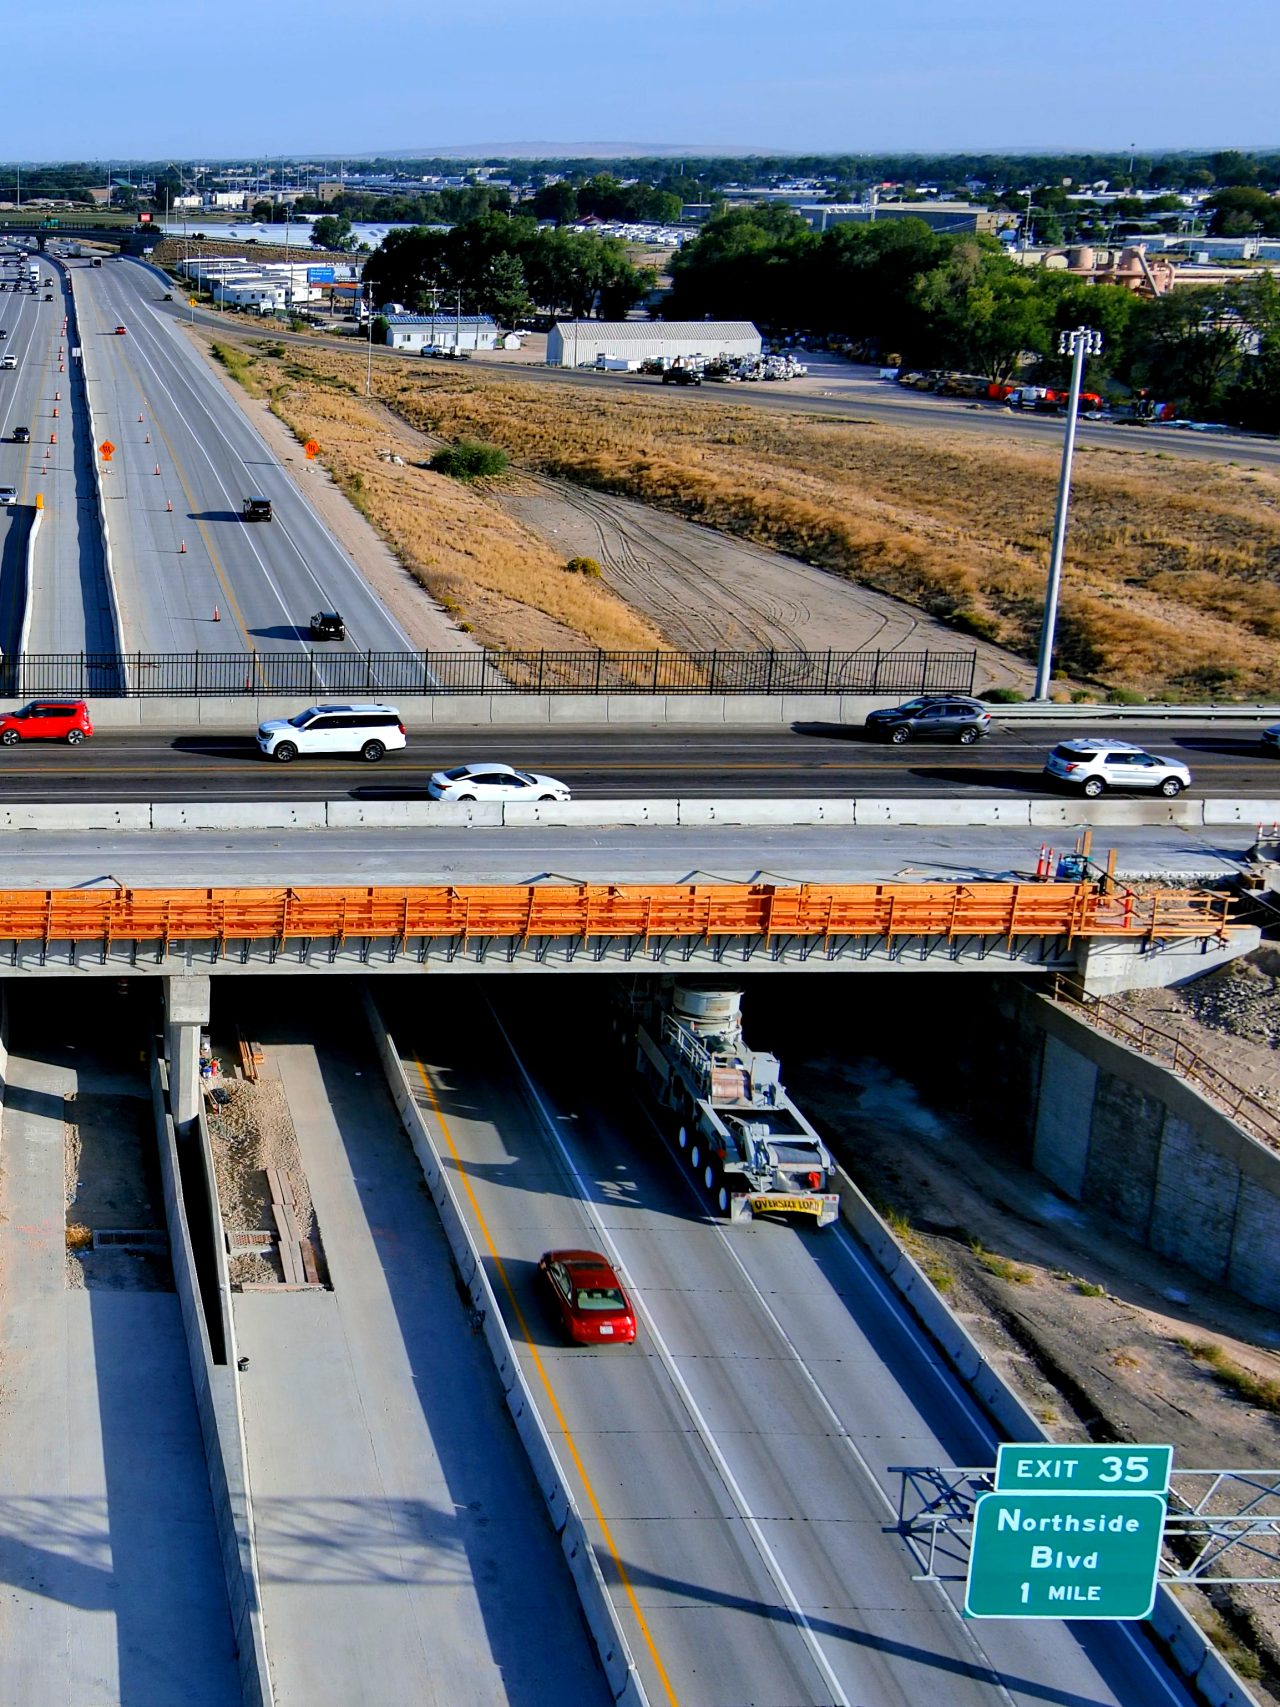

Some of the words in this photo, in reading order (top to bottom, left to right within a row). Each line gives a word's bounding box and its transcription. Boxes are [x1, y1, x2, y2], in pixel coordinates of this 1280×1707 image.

[755, 1199, 797, 1210] OVERSIZE
[800, 1200, 820, 1211] LOAD
[1017, 1459, 1079, 1478] EXIT
[1098, 1456, 1149, 1483] 35
[997, 1508, 1140, 1532] Northside
[1030, 1545, 1098, 1569] Blvd
[1020, 1582, 1030, 1603] 1
[1048, 1585, 1101, 1601] MILE
